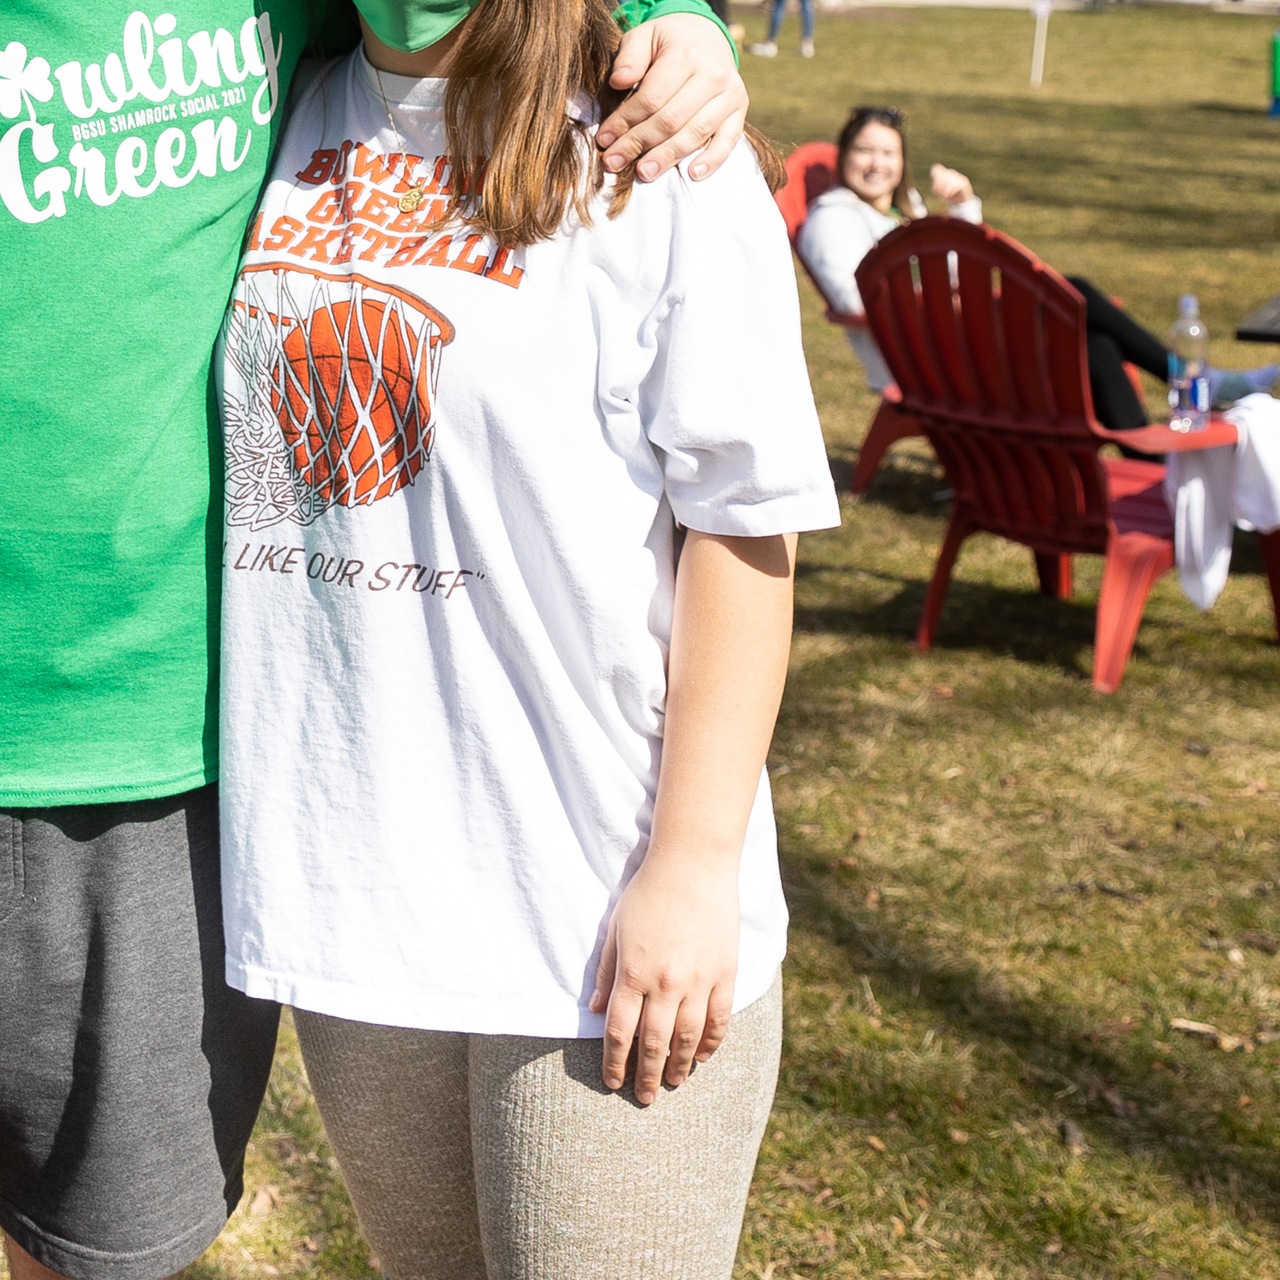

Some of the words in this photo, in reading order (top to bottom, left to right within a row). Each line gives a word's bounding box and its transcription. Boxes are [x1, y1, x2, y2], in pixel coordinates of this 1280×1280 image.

[72, 119, 107, 142] BGSU
[110, 103, 177, 134] SHAMROCK
[180, 94, 220, 119] SOCIAL
[221, 86, 247, 108] 2021
[295, 139, 486, 195] BOWLI
[233, 543, 306, 573] LIKE
[306, 552, 364, 588] OUR
